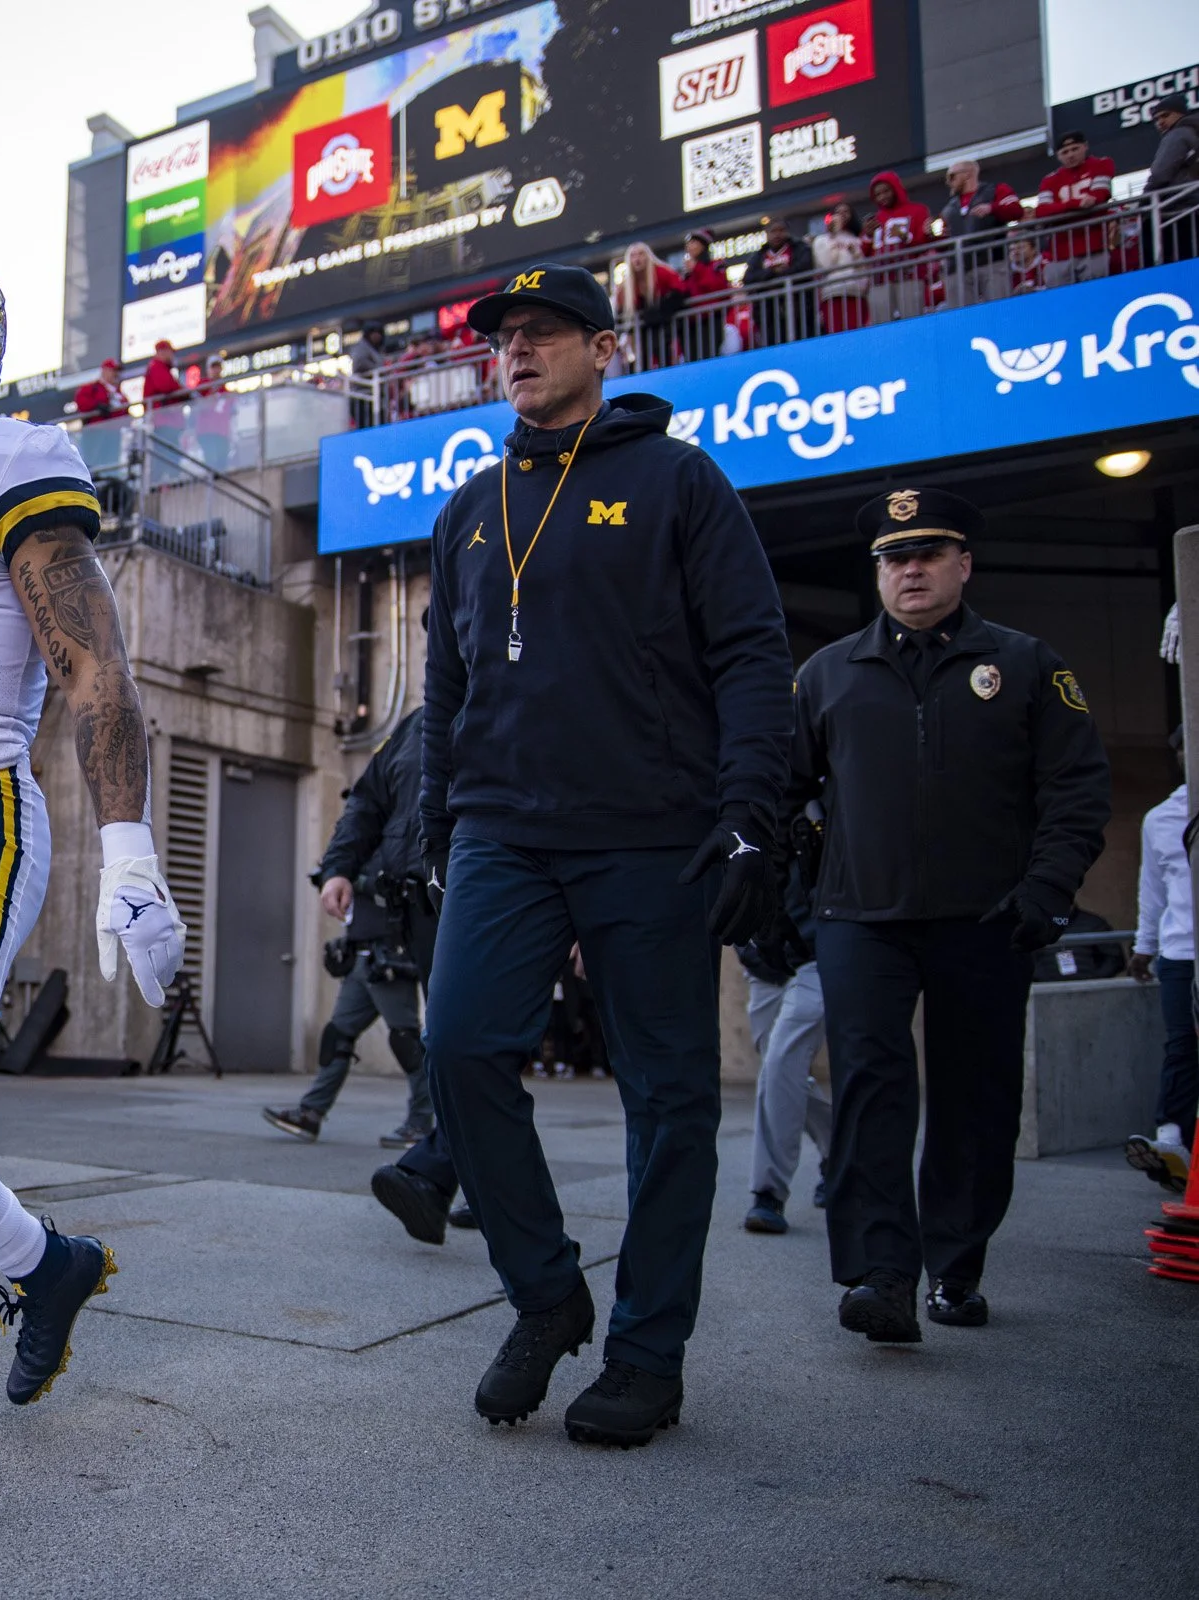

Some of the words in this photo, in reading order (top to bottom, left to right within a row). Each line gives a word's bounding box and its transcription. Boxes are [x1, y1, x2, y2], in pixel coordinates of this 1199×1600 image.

[297, 9, 400, 71] OHIO
[673, 55, 746, 112] SFU
[434, 89, 506, 160] M
[814, 118, 839, 145] TO
[252, 257, 317, 287] TODAY'S
[317, 243, 363, 271] GAME
[363, 238, 382, 259] IS
[382, 213, 480, 253] PRESENTED
[479, 204, 508, 227] BY
[510, 270, 546, 294] M
[1081, 292, 1199, 390] Kro
[714, 368, 906, 460] Kroger
[587, 500, 628, 525] M
